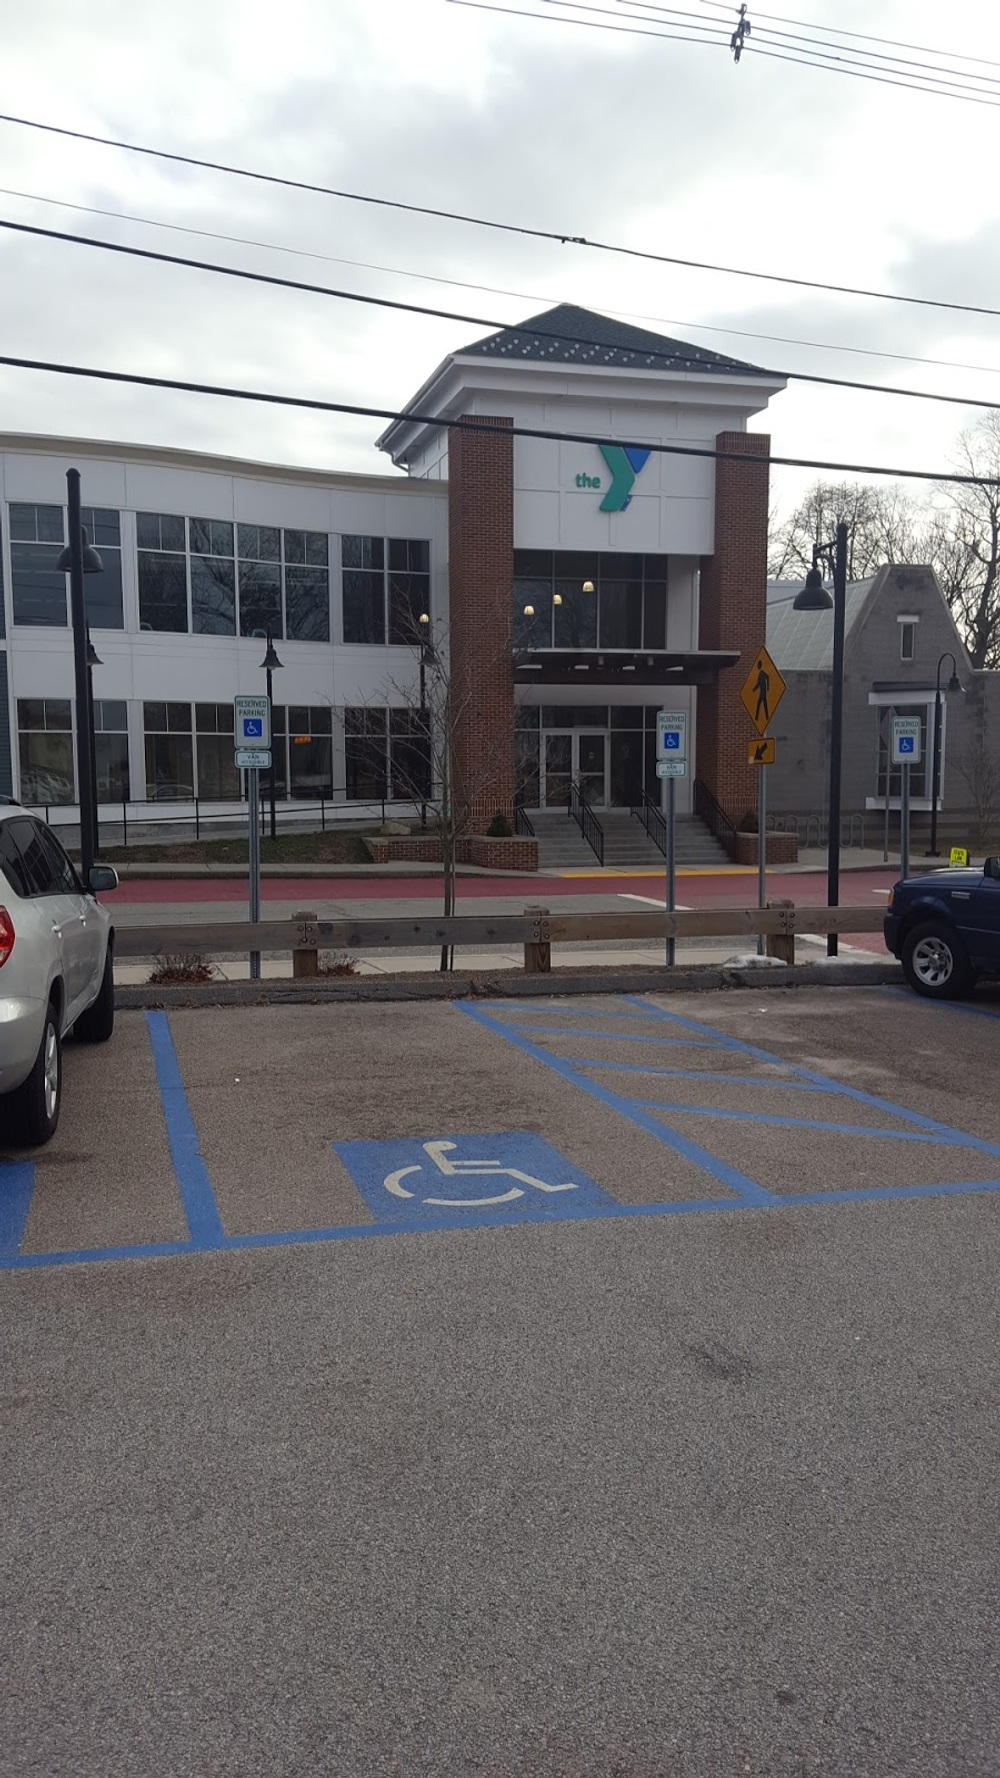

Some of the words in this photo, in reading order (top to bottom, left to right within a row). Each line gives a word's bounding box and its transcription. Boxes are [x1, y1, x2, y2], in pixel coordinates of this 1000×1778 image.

[575, 472, 601, 489] the
[237, 700, 267, 708] RESERVED
[894, 720, 918, 728] RESERVED
[896, 728, 917, 736] PARKING
